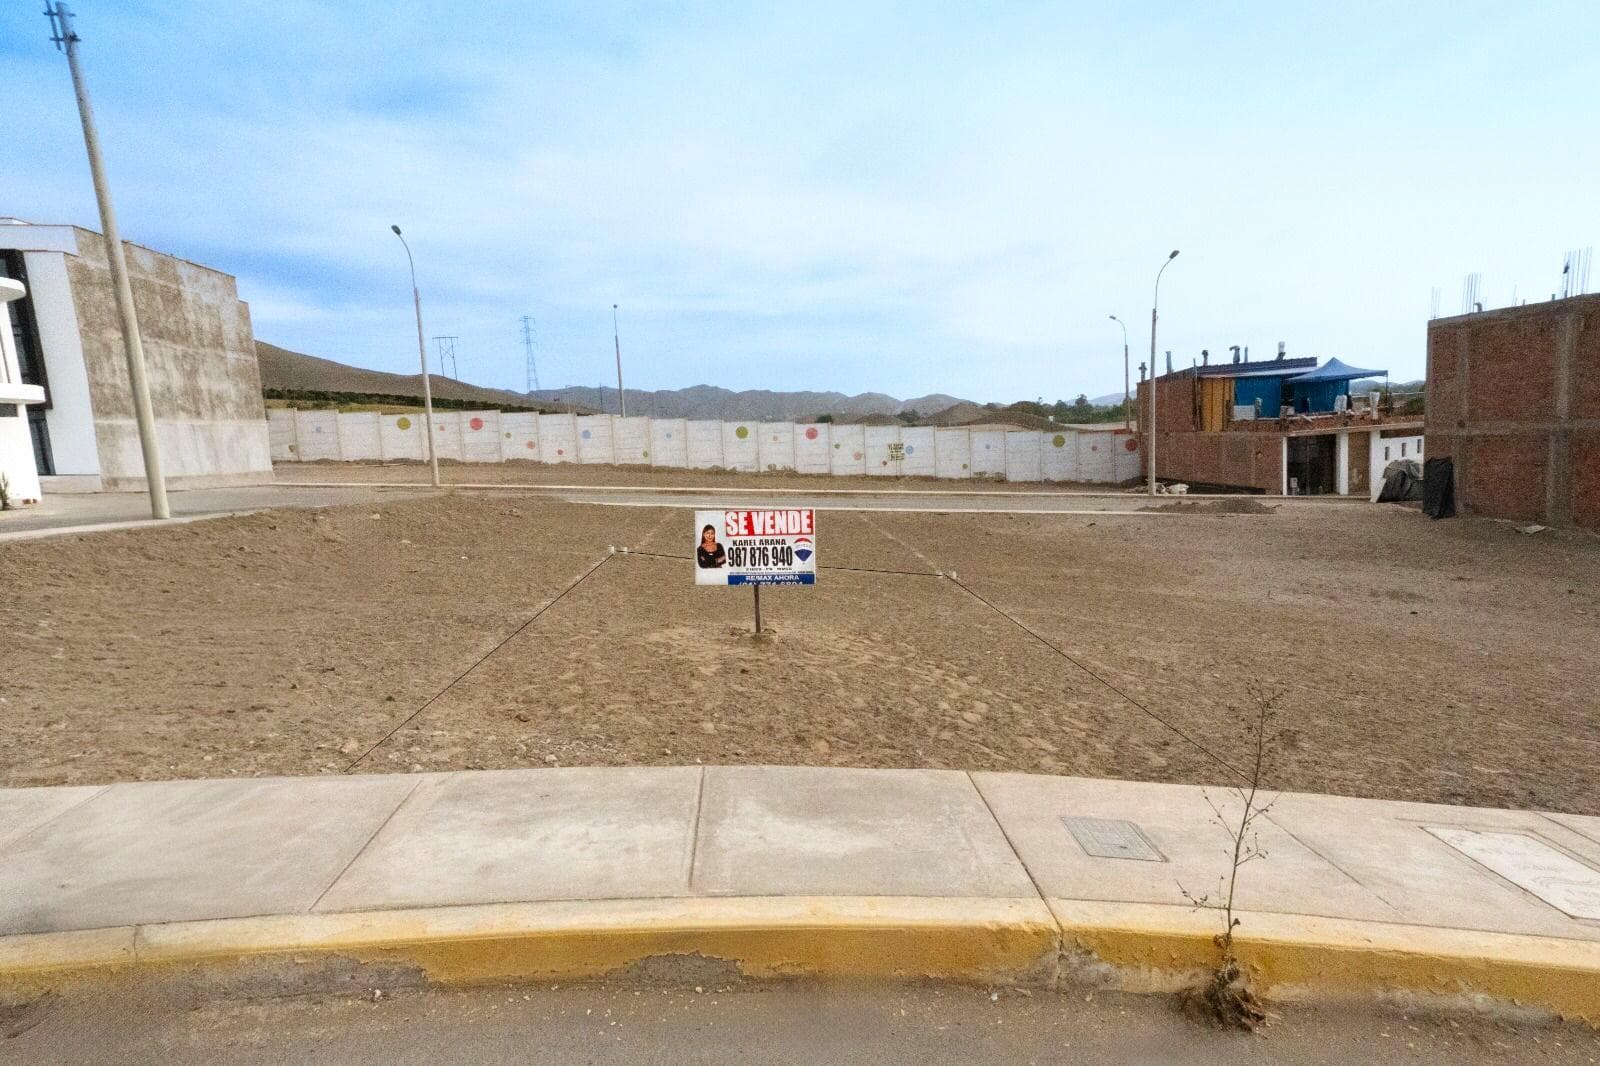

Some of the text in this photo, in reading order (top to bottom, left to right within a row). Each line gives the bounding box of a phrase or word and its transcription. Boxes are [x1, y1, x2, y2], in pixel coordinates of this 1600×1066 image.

[726, 510, 812, 536] SE VENDE
[759, 538, 786, 546] ARANA
[728, 546, 793, 567] 987 876 940
